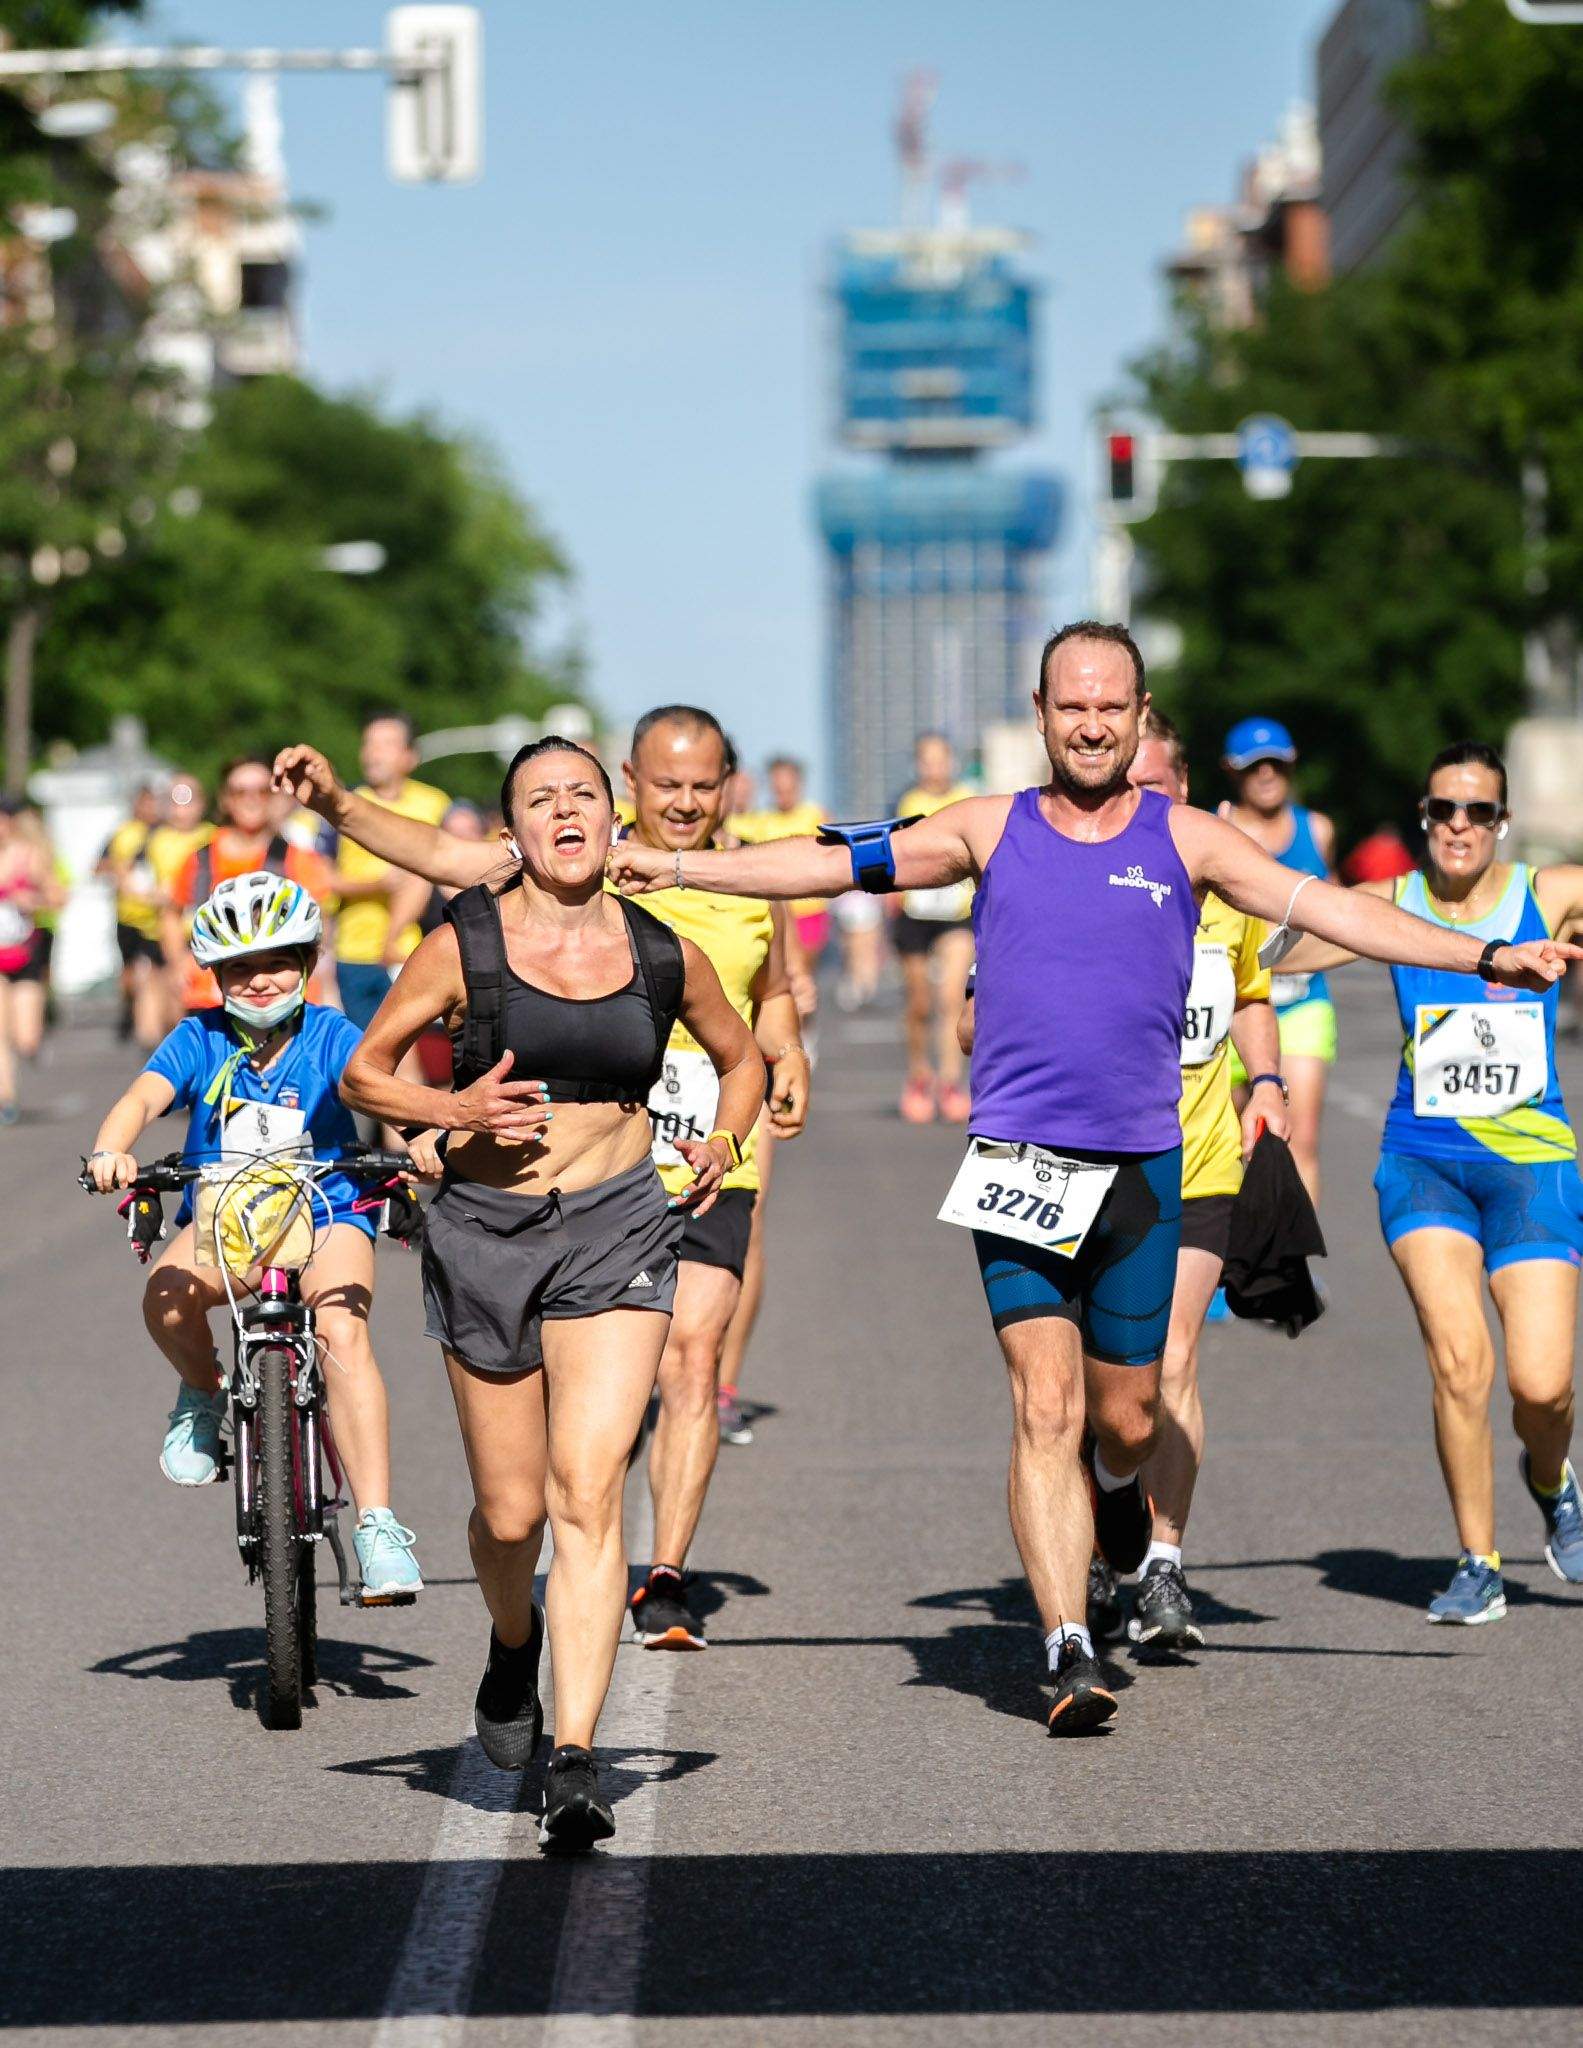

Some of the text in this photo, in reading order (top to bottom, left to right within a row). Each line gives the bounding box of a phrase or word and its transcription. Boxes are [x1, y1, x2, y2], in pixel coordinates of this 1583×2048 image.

[1183, 1006, 1214, 1040] 87
[1443, 1063, 1521, 1095] 3457
[976, 1182, 1064, 1231] 3276
